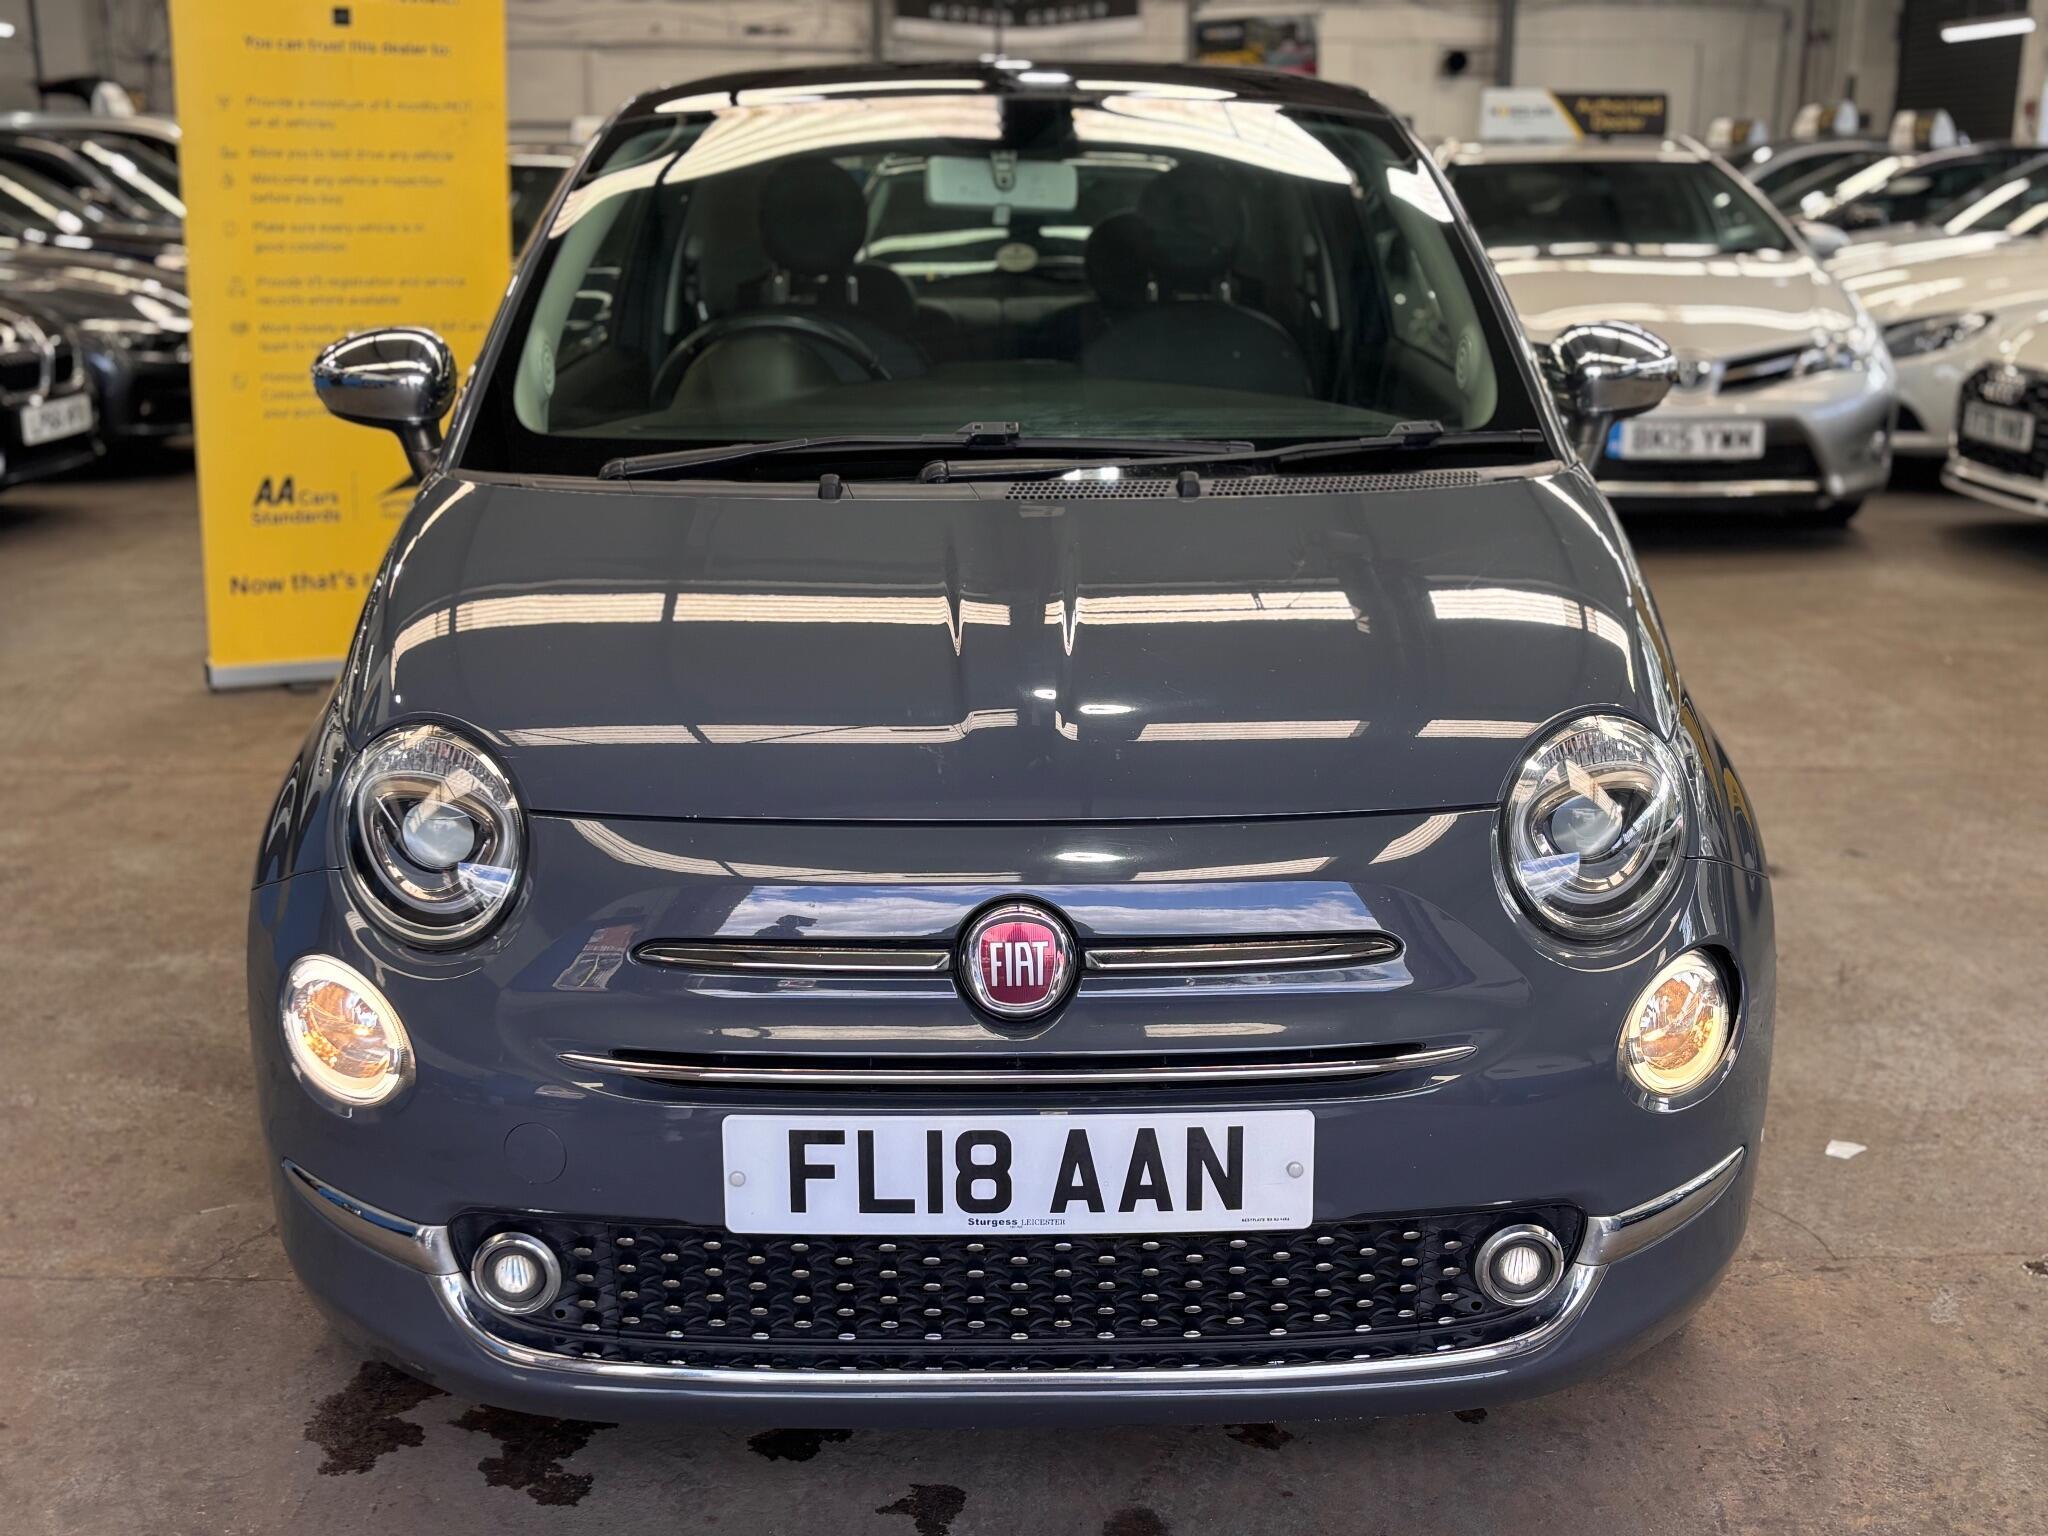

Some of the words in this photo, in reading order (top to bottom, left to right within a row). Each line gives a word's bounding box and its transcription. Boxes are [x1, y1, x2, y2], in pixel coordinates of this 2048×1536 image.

[255, 476, 294, 506] AA
[300, 489, 340, 505] Cars
[252, 508, 342, 527] Standards
[229, 574, 284, 596] Now
[290, 570, 357, 592] that's
[989, 941, 1049, 987] FIAT
[788, 1129, 1013, 1214] FL18
[1049, 1125, 1244, 1214] AAN
[967, 1217, 1018, 1227] Sturgess
[1021, 1218, 1066, 1226] LEICESTER
